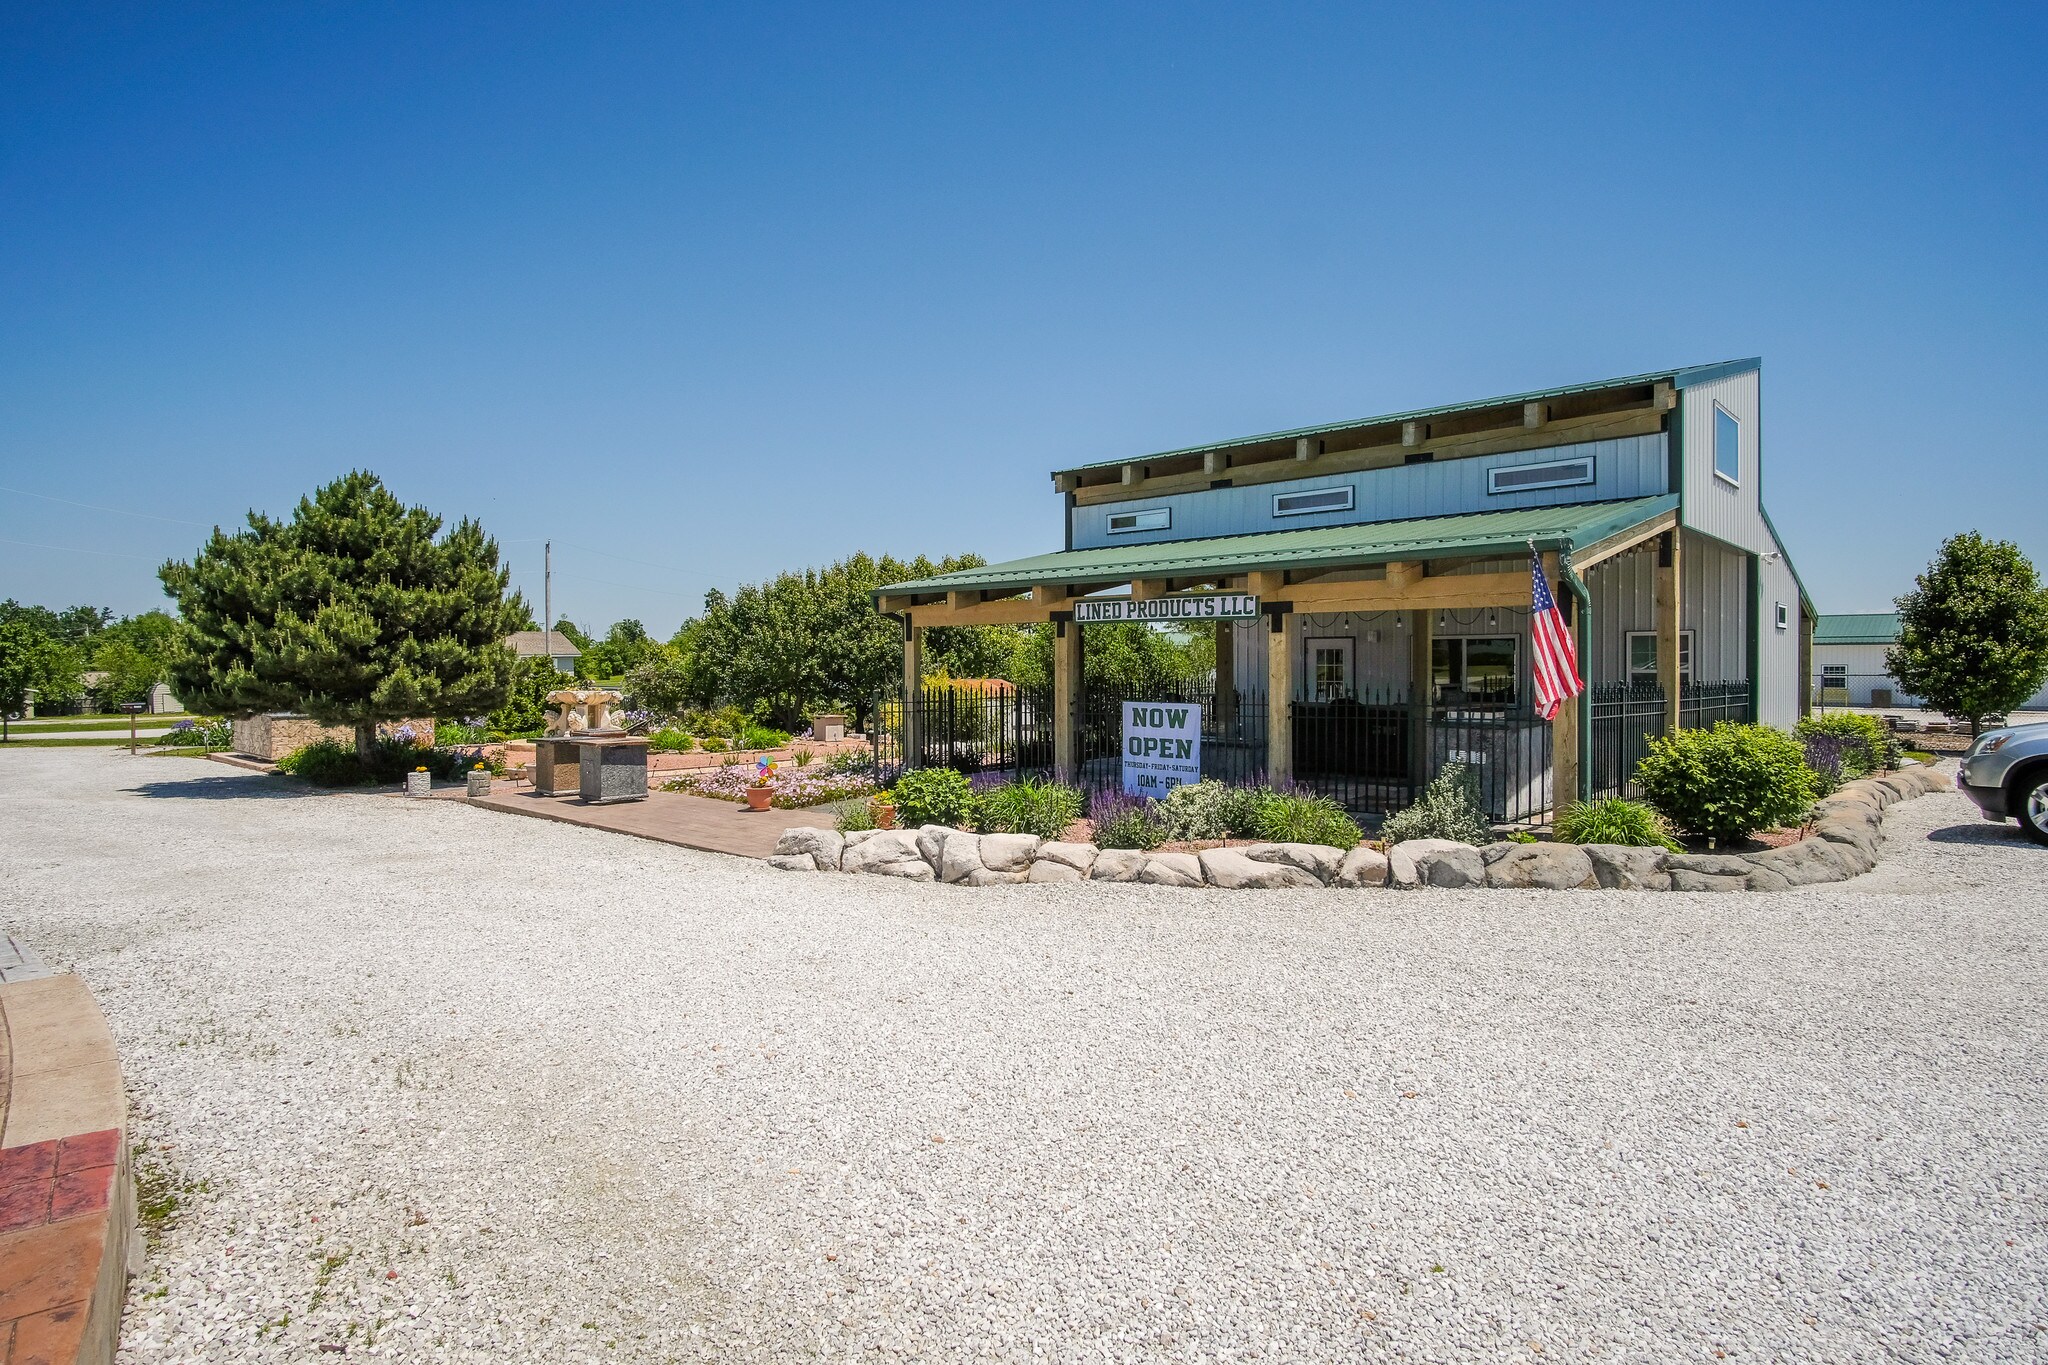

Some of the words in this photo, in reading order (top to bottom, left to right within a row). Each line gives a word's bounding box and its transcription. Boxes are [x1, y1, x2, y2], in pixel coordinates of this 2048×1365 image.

[1077, 602, 1122, 620] LINED
[1127, 598, 1215, 618] PRODUCTS
[1220, 597, 1254, 615] LLC
[1132, 708, 1188, 728] NOW
[1129, 737, 1192, 759] OPEN
[1137, 774, 1157, 788] 10AM
